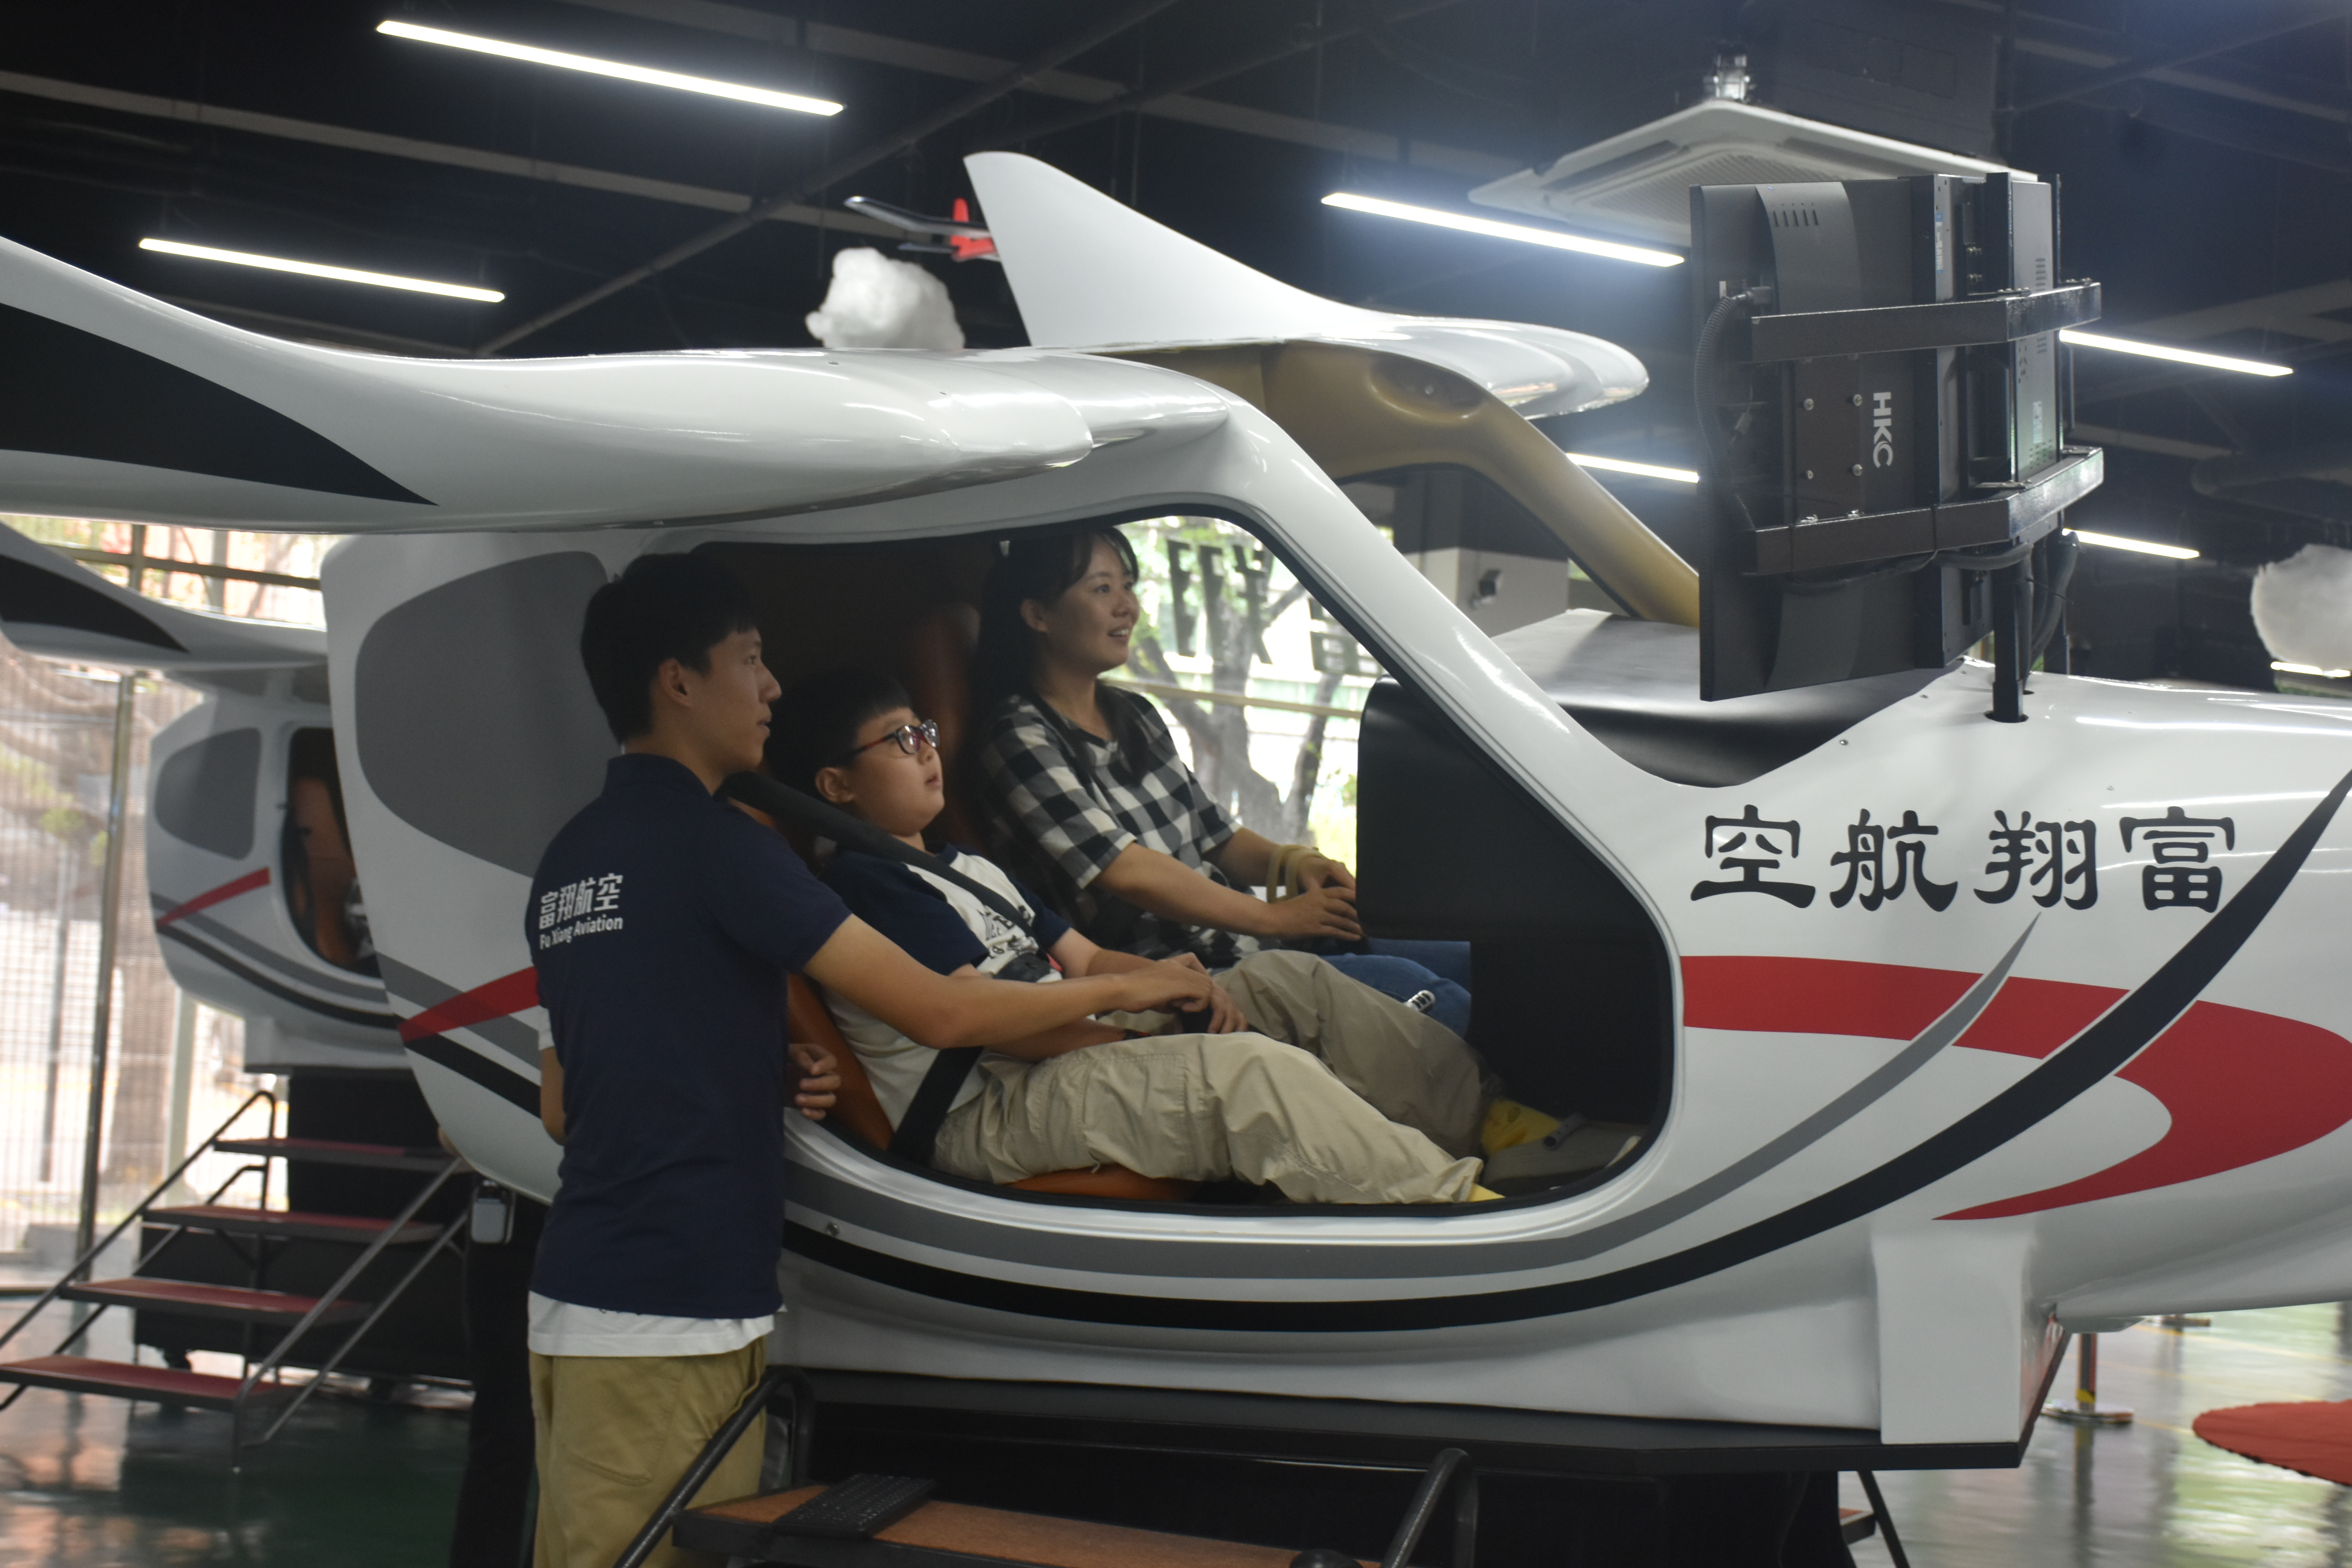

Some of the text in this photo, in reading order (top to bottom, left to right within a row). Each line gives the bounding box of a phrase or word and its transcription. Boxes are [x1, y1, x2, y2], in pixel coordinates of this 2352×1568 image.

[1873, 392, 1893, 468] HKC
[539, 873, 623, 929] 富翔航空
[539, 914, 623, 950] Fu Xiang Aviation
